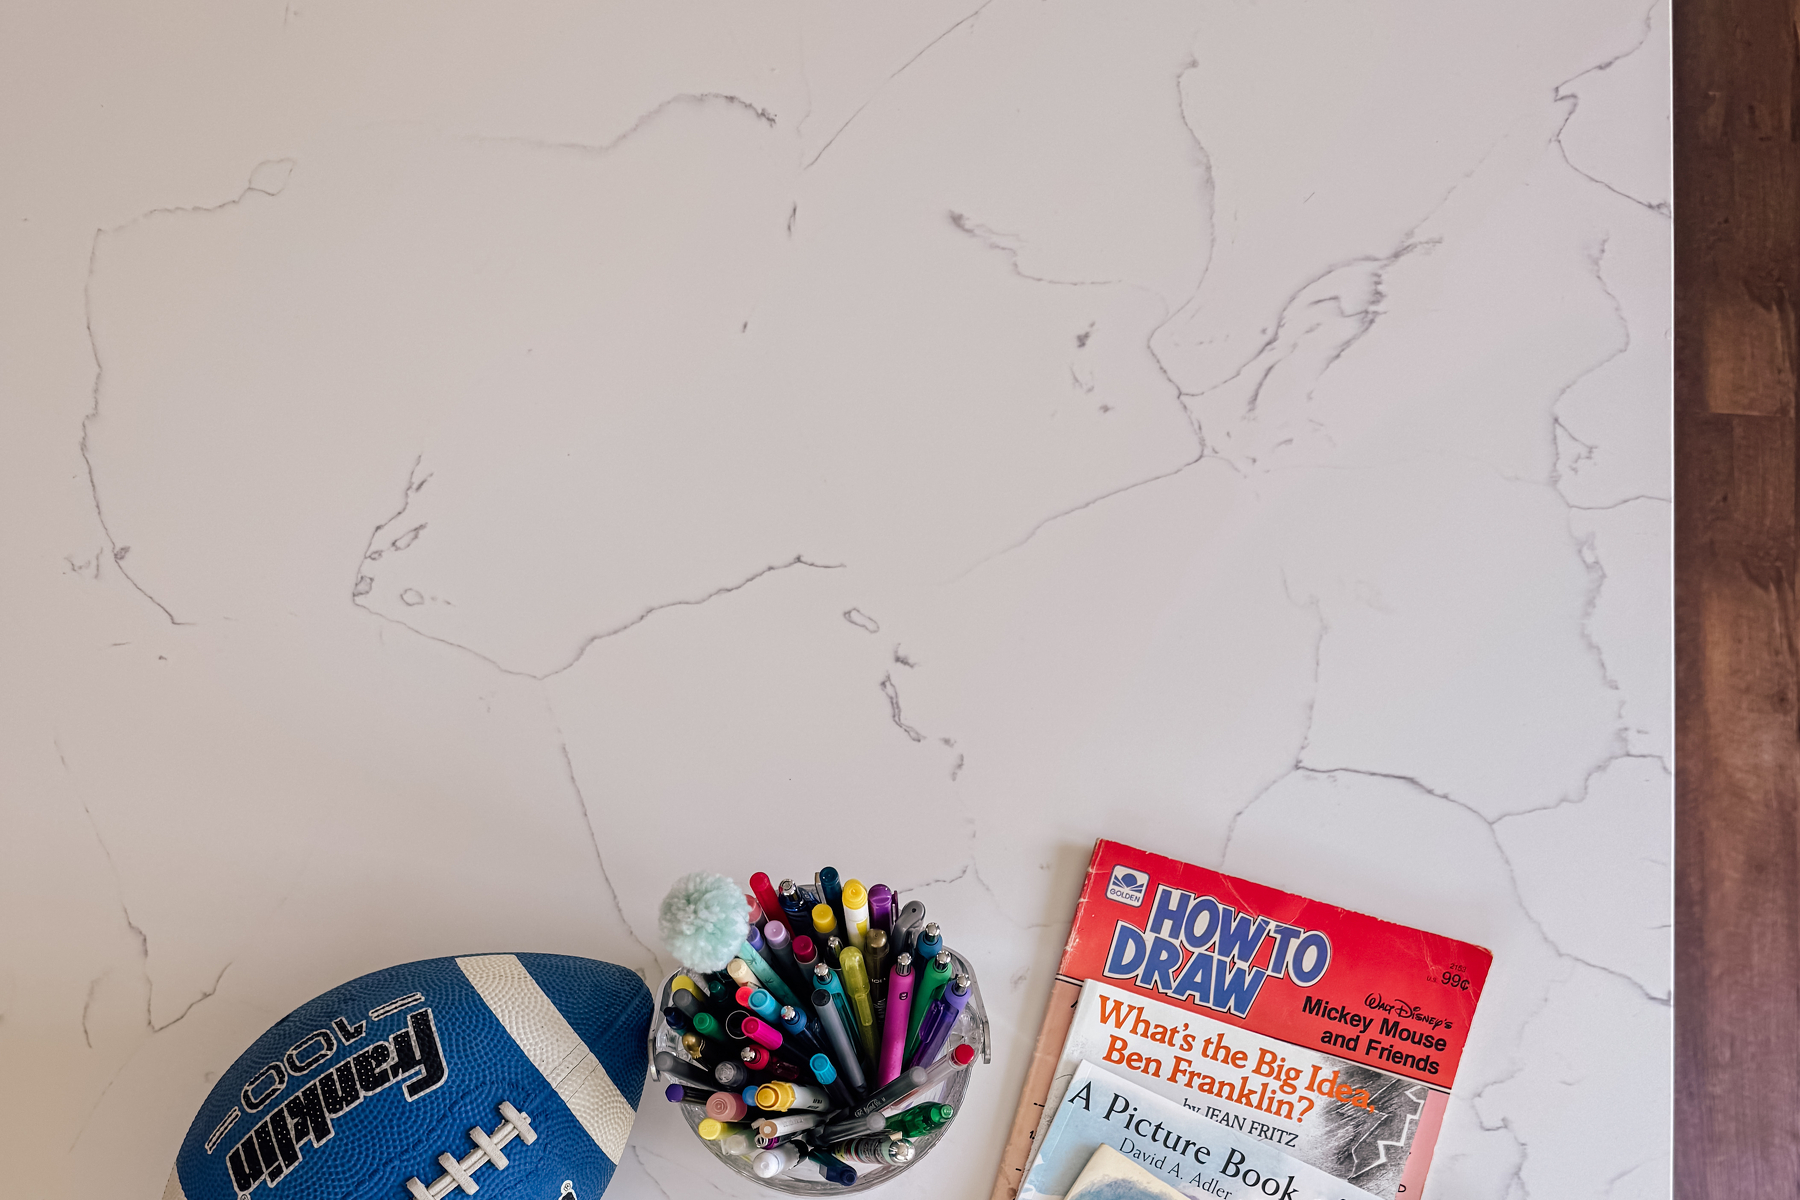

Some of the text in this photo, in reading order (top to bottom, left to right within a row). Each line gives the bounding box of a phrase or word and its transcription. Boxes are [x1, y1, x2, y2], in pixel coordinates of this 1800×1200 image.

[1109, 888, 1141, 904] GOLDEN
[1103, 919, 1268, 1019] DRAW
[1146, 884, 1331, 987] HOW TO
[1441, 971, 1470, 991] 99¢
[1099, 994, 1376, 1113] What's the Big Idea,
[1302, 996, 1447, 1051] Mickey Mouse
[1320, 1030, 1440, 1075] and Friends
[241, 1016, 366, 1113] 100
[1102, 1034, 1315, 1123] Ben Franklin?
[1068, 1080, 1092, 1111] A
[1102, 1092, 1211, 1165] Picture
[1200, 1105, 1247, 1132] JEAN
[1248, 1120, 1299, 1149] FRITZ
[1119, 1137, 1167, 1170] David
[1168, 1162, 1184, 1180] A.
[1188, 1171, 1234, 1200] Adler
